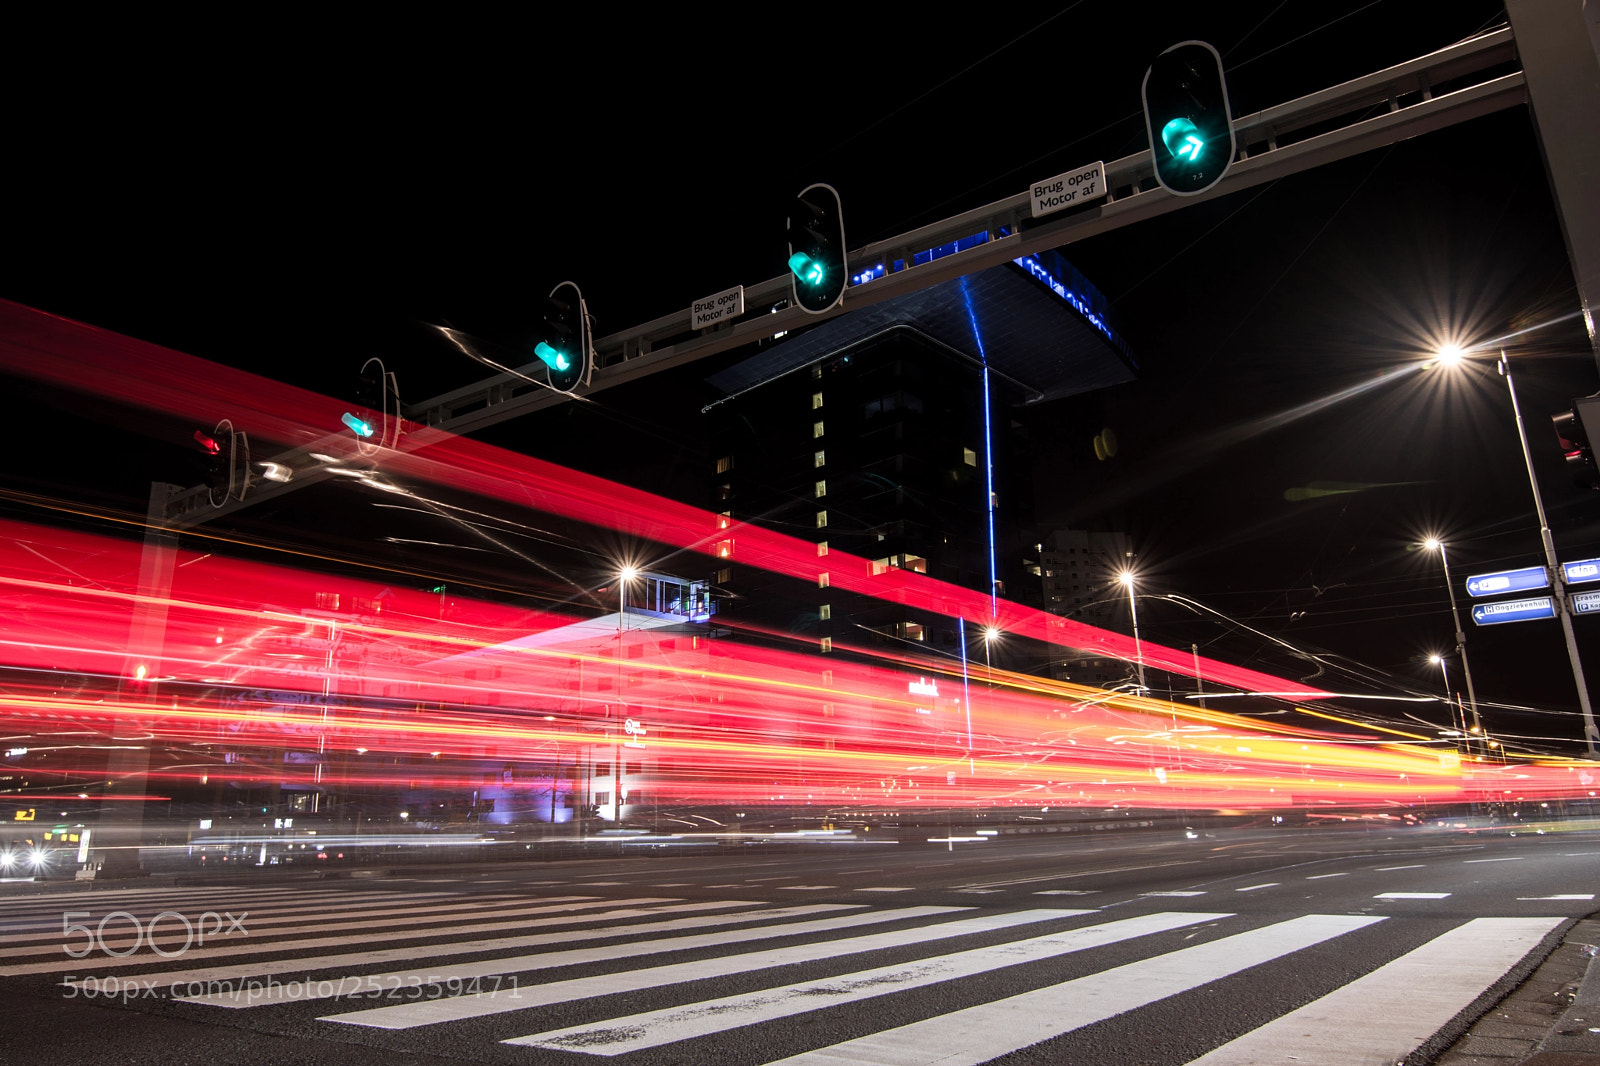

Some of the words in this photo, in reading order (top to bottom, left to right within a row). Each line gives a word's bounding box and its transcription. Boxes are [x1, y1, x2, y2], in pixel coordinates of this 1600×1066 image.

[1034, 181, 1064, 198] Brug
[1068, 168, 1099, 186] open
[1040, 190, 1078, 210] Motor
[1082, 182, 1096, 196] af
[694, 300, 715, 313] Brug
[717, 292, 739, 305] open
[697, 309, 723, 324] Motor
[726, 303, 736, 315] af
[1495, 601, 1549, 612] Oogziekenhuis
